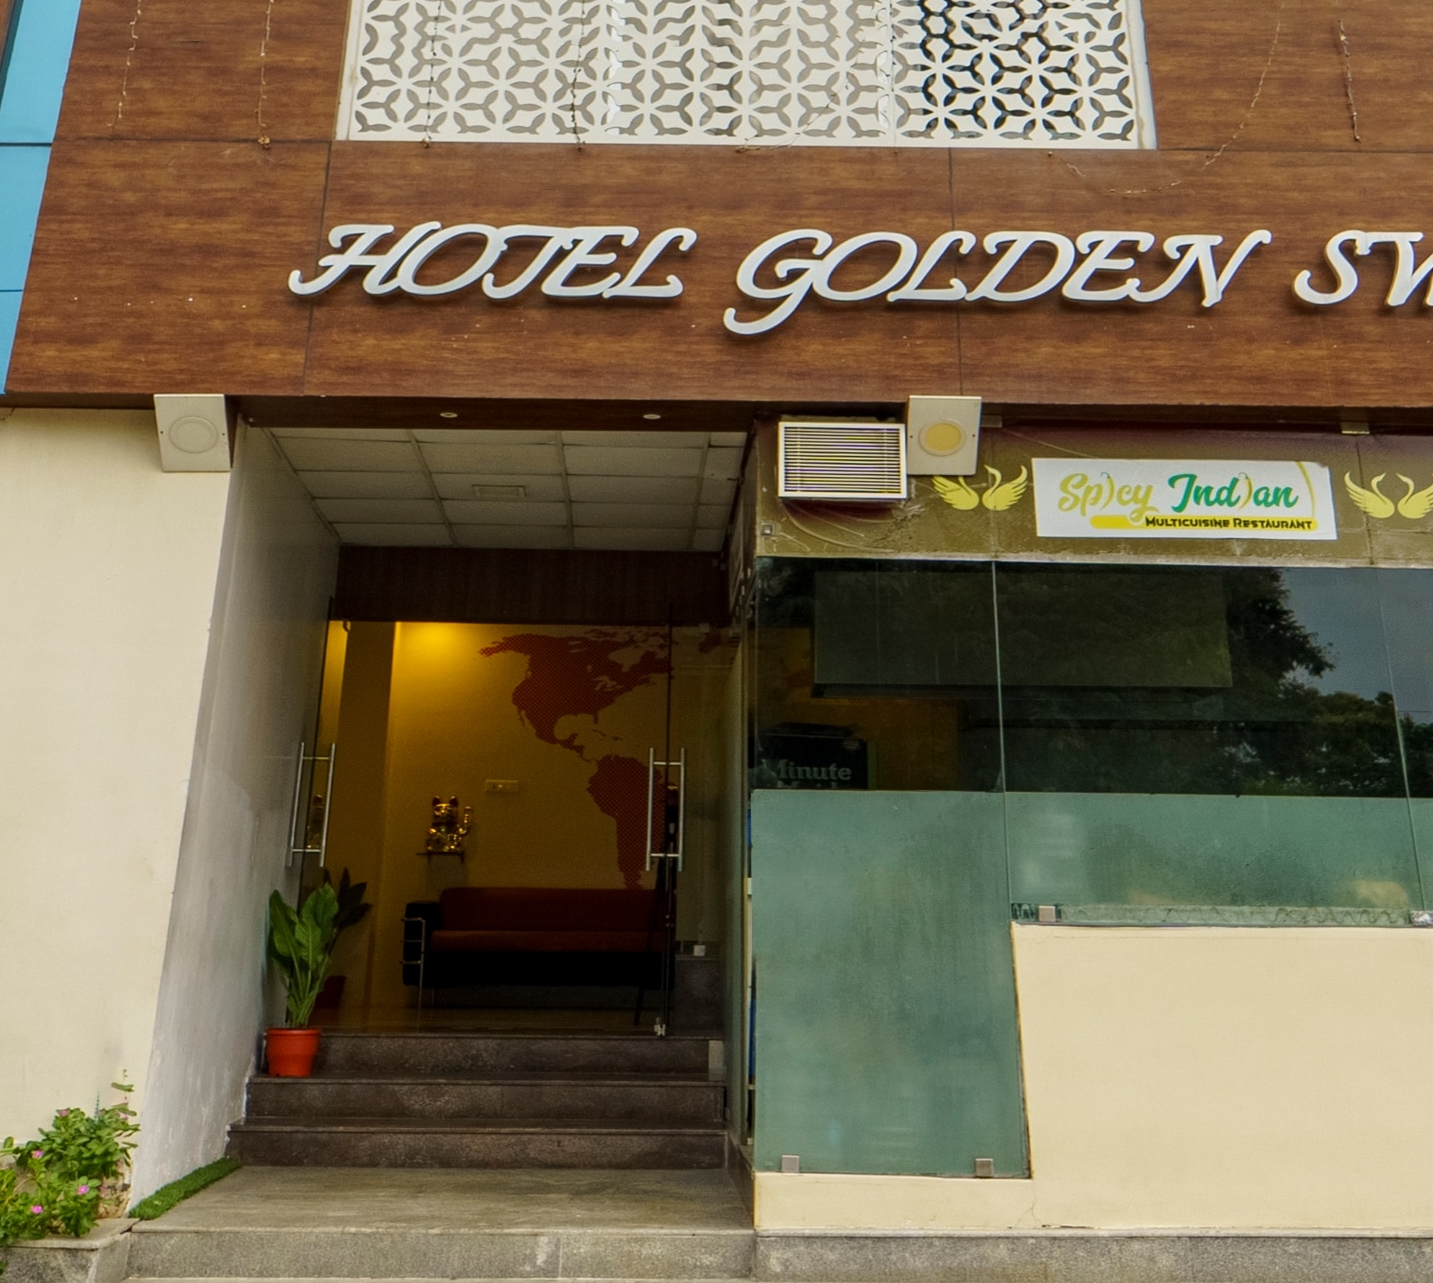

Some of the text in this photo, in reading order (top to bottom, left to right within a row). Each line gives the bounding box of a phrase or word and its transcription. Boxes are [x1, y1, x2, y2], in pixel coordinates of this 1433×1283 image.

[289, 220, 698, 301] HOTEL
[722, 228, 1272, 335] GOLDEN
[1057, 471, 1299, 523] Spicy Indian
[1144, 516, 1314, 531] MULTICUISINE RESTAURANT
